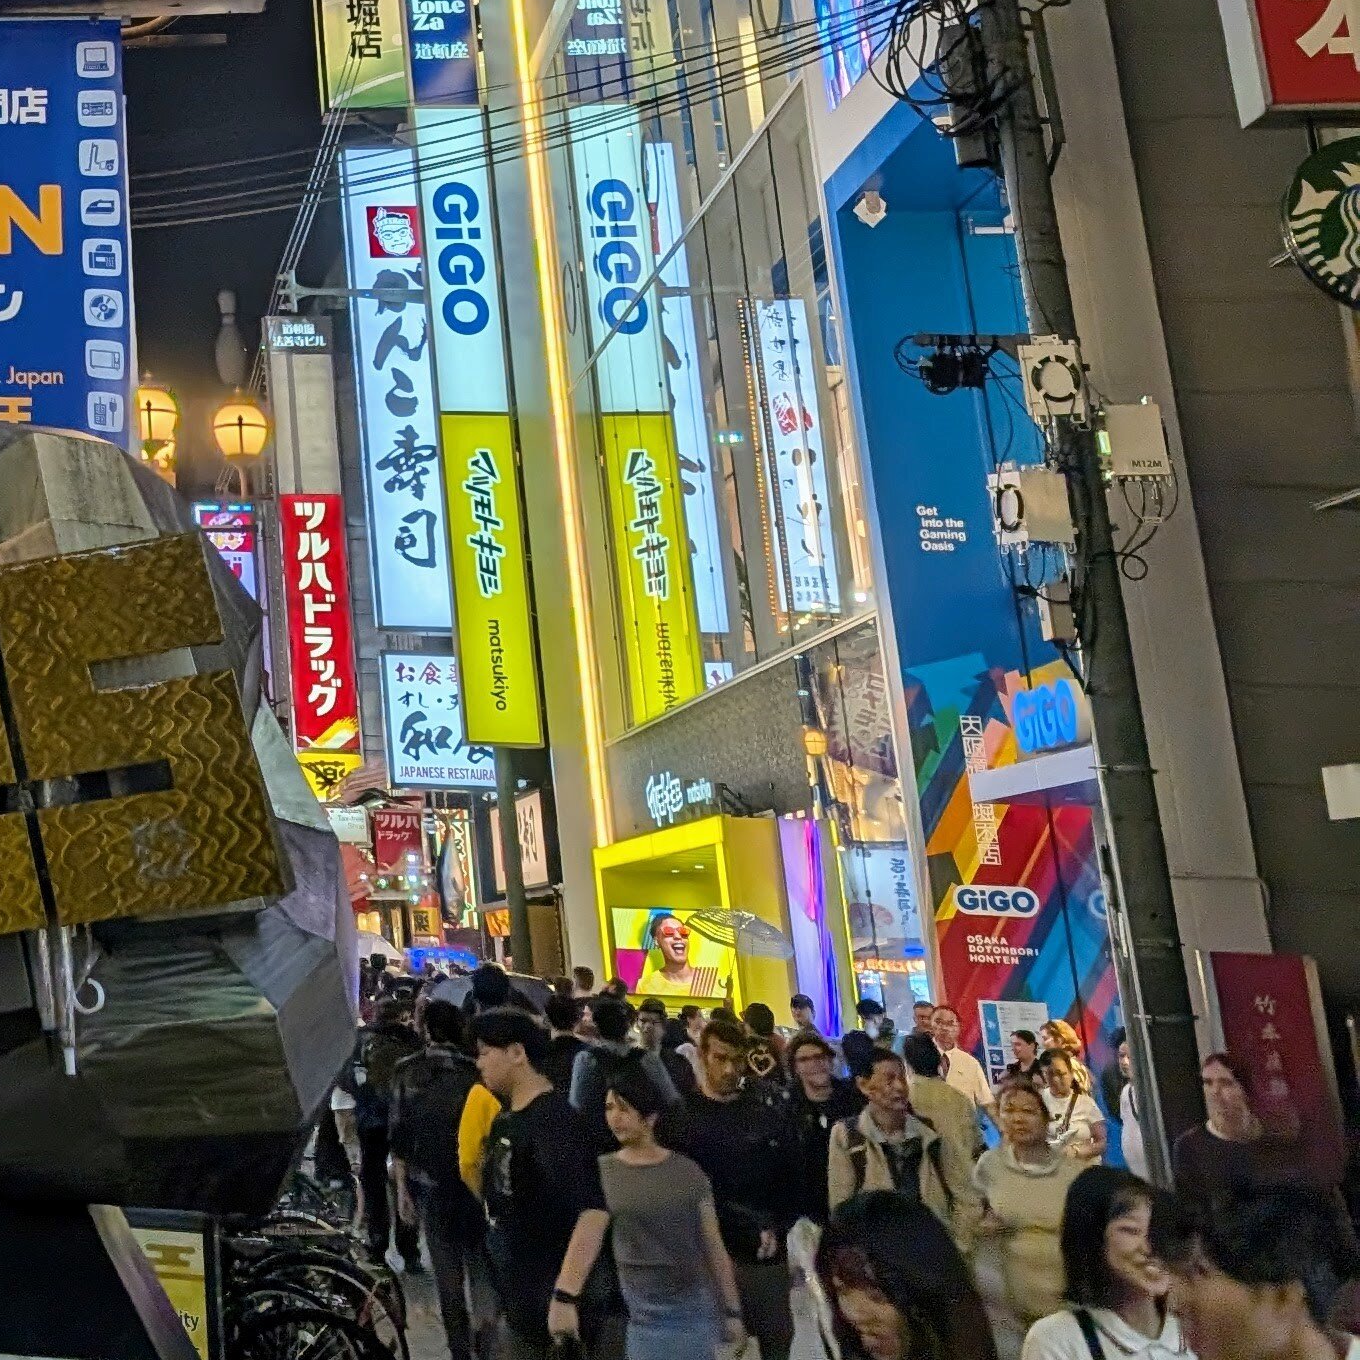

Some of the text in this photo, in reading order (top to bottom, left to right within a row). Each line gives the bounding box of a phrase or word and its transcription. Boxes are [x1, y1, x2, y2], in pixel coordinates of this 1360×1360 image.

[413, 14, 445, 30] Za
[415, 41, 469, 59] 道頓座
[432, 181, 490, 336] GiGO
[6, 367, 64, 389] Japan
[916, 505, 938, 516] Get
[945, 517, 964, 527] the
[920, 529, 967, 541] Gaming
[921, 541, 954, 551] Oasis
[294, 502, 341, 716] ツルハドラッグ
[487, 619, 510, 711] matsukiyo
[1013, 679, 1077, 753] GiGO
[400, 766, 445, 778] JAPANESE
[376, 814, 420, 829] ツルハ
[377, 831, 412, 841] ドラッグ
[957, 889, 1035, 913] GiGO
[967, 935, 1008, 946] OSAKA
[969, 945, 1039, 958] DOTONBORI
[970, 954, 1019, 965] HONTEN
